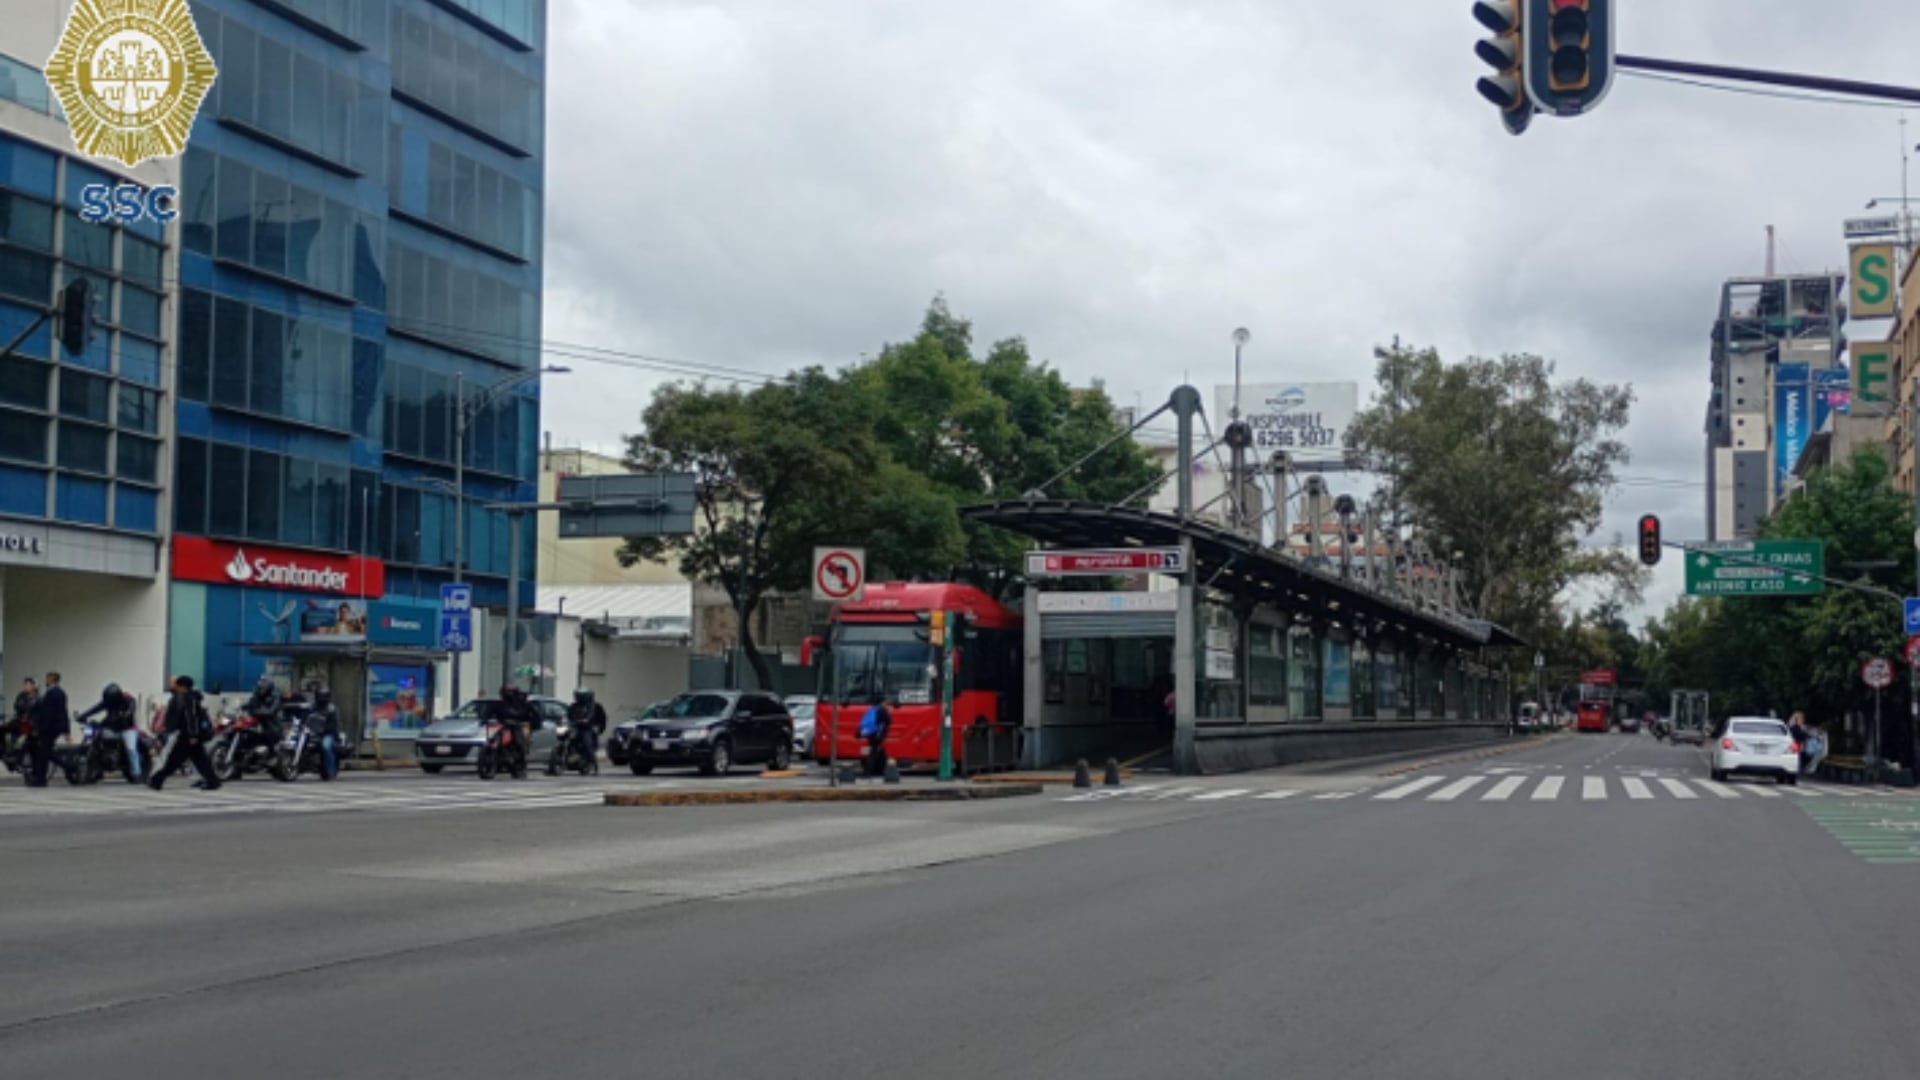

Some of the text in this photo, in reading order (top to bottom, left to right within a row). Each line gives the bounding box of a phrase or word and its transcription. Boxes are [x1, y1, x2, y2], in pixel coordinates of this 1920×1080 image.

[1857, 254, 1889, 304] S
[1247, 412, 1322, 429] DISPONIBLE
[254, 558, 348, 590] Santander
[1695, 580, 1785, 591] ANTONIO CASO
